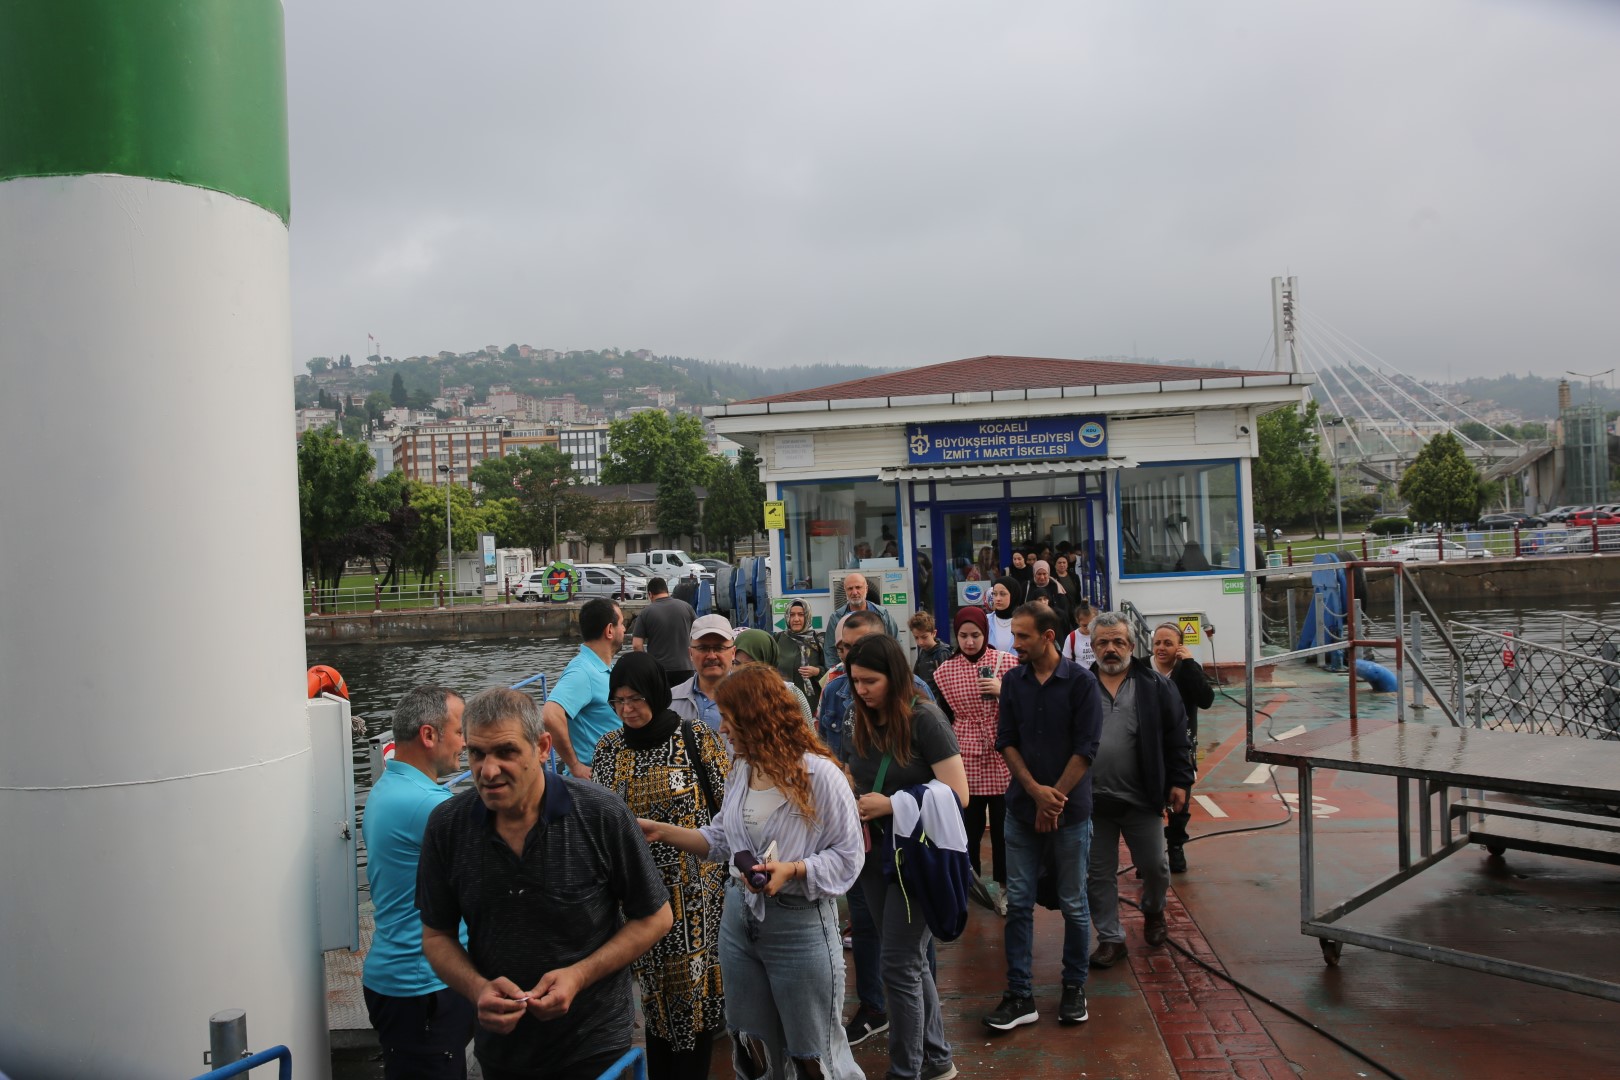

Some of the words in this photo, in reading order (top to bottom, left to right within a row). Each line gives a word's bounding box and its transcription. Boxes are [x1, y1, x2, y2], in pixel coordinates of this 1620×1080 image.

[979, 421, 1028, 434] KOCAELİ
[935, 434, 1007, 449] BÜYÜKŞEHİR
[1009, 430, 1074, 445] BELEDİYESİ
[943, 448, 971, 460] İZMİT
[974, 450, 980, 458] 1
[983, 447, 1014, 458] MART
[1017, 443, 1067, 457] İSKELESİ
